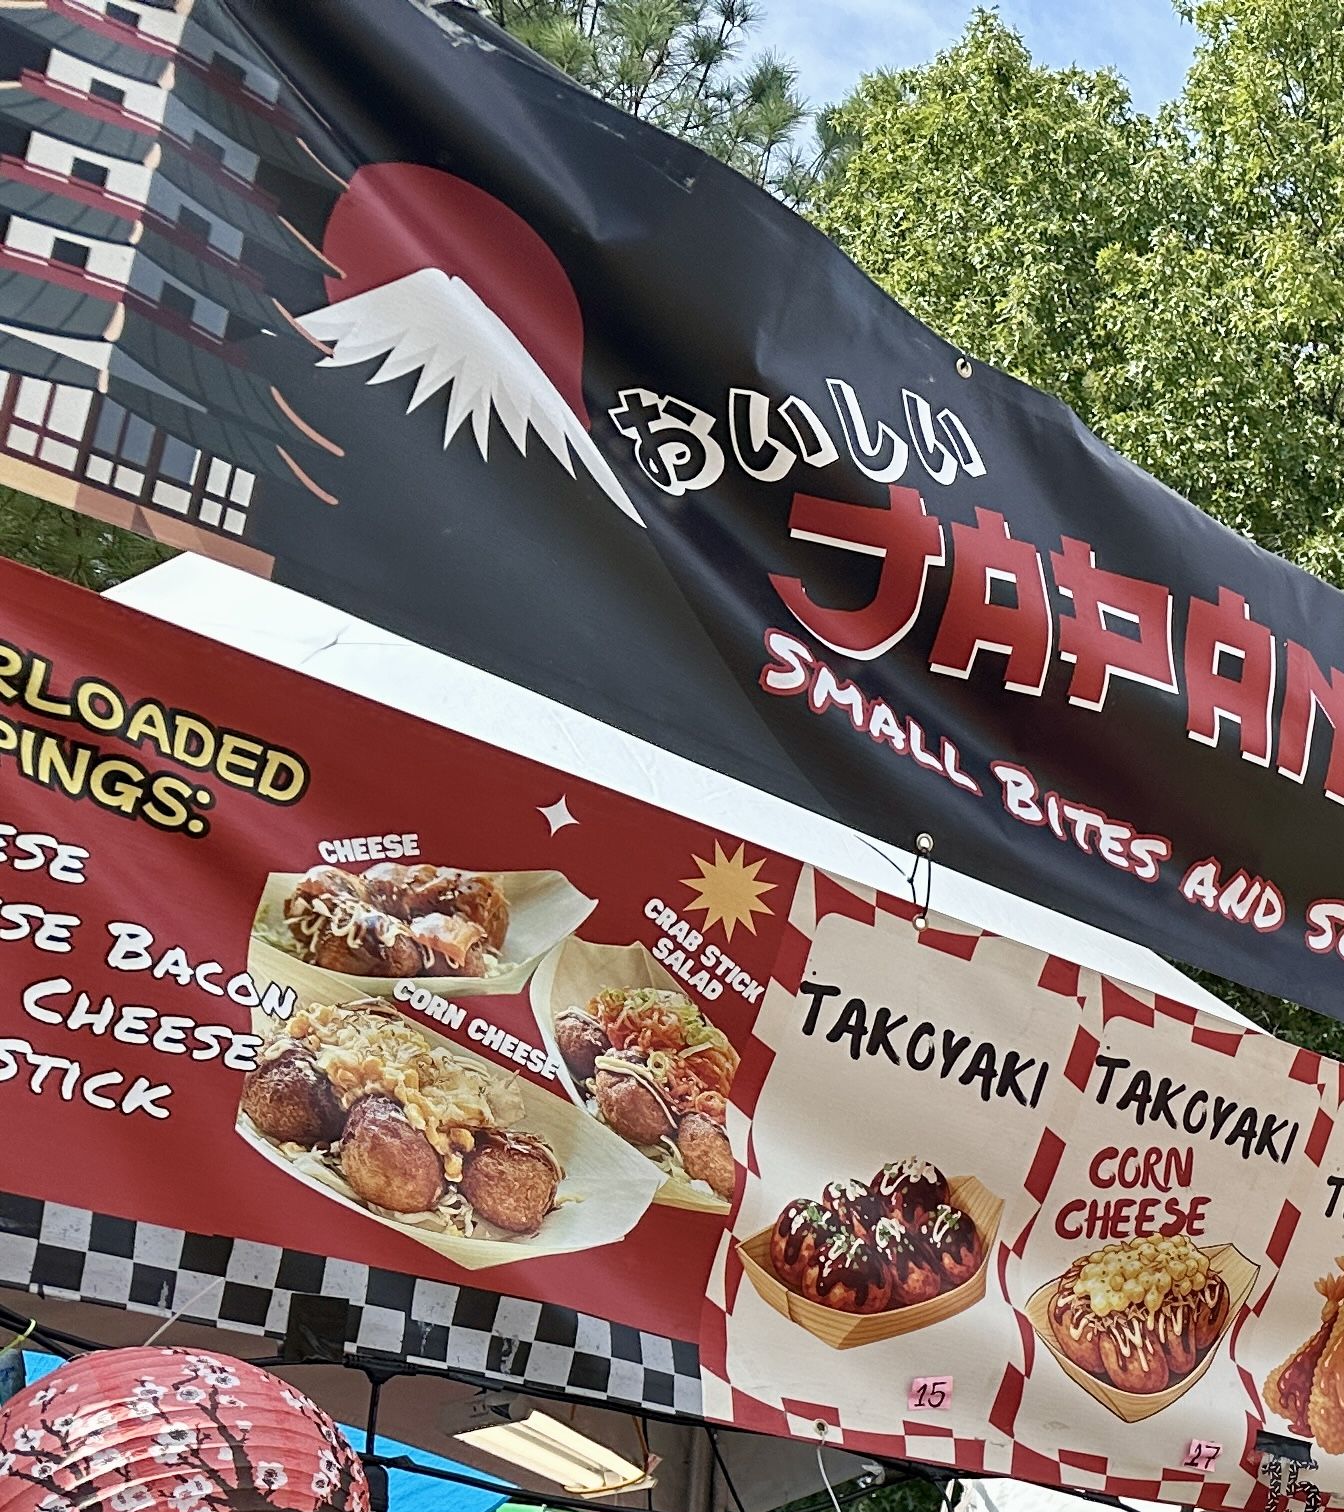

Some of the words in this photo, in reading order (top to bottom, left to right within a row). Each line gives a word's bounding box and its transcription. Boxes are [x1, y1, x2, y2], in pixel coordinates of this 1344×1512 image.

[608, 378, 987, 497] おいしい
[760, 630, 983, 796] SMALL
[992, 762, 1171, 880] BITES
[1180, 857, 1286, 932] AND
[318, 833, 421, 866] CHEESE
[107, 921, 298, 1021] BACON
[643, 897, 704, 954] CRAB
[697, 947, 766, 1005] STICK
[651, 936, 725, 1003] SALAD
[22, 977, 265, 1072] CHEESE
[393, 979, 466, 1032] CORN
[467, 1017, 561, 1083] CHEESE
[800, 980, 1050, 1109] TAKOYAKI
[1095, 1053, 1299, 1164] TAKOYAKI
[1088, 1146, 1194, 1192] CORN
[1055, 1196, 1212, 1240] CHEESE
[912, 1380, 948, 1410] 15
[1184, 1443, 1221, 1470] 17
